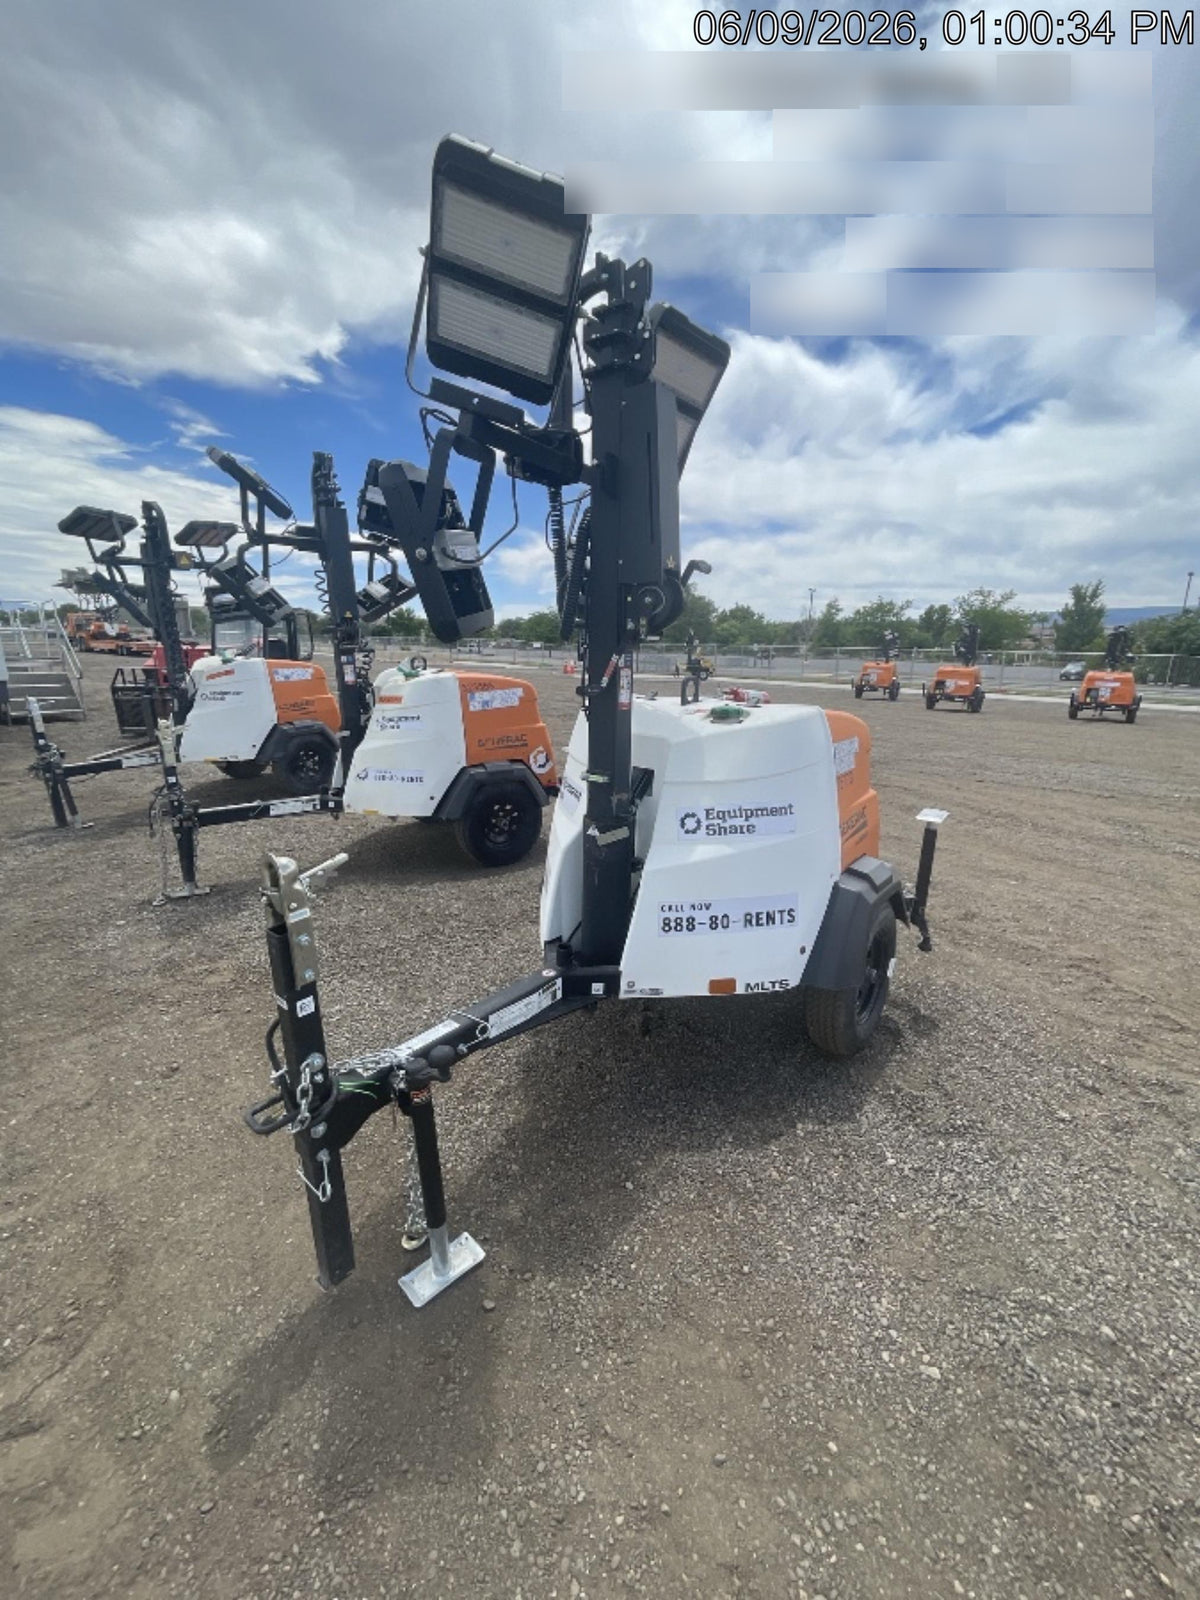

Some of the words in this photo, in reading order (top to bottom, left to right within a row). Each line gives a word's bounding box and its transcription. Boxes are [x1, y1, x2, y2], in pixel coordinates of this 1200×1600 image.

[704, 803, 794, 823] Equipment
[705, 822, 756, 836] Share
[660, 904, 685, 913] CALL
[690, 902, 712, 911] NOW
[744, 979, 790, 993] MLTS
